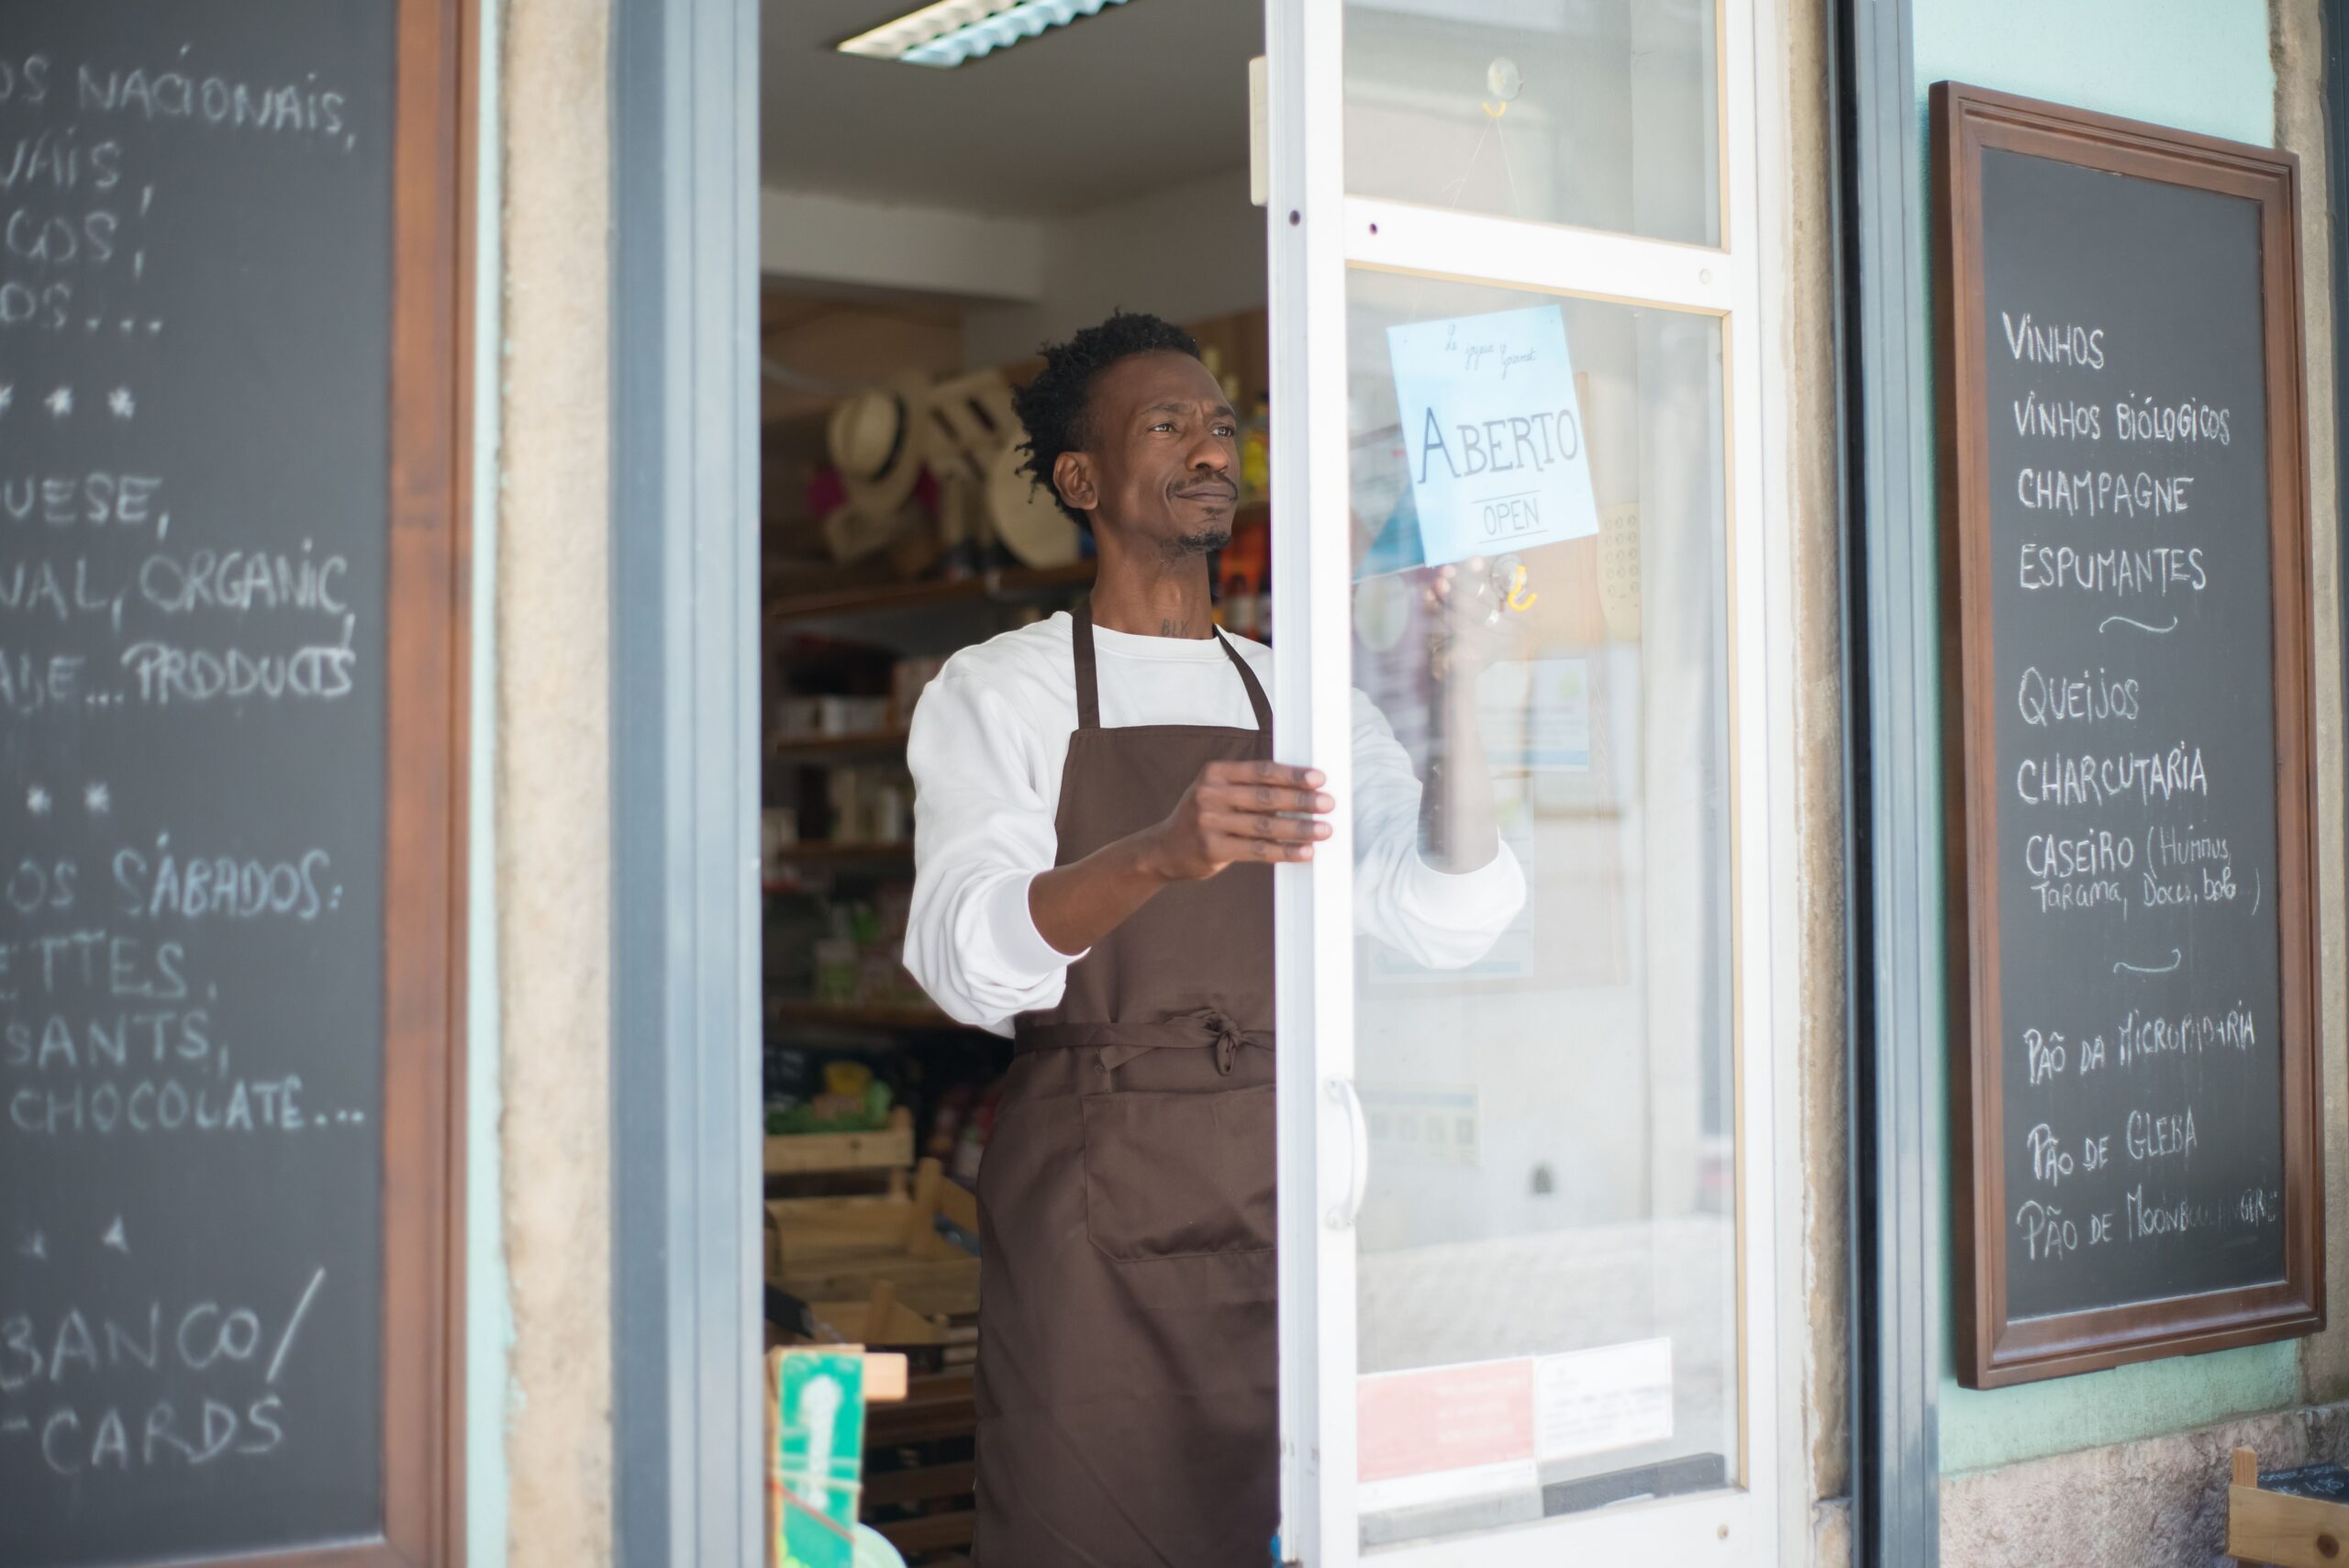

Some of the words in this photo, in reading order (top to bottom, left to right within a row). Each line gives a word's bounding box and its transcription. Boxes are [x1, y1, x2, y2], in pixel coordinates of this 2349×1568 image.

[1417, 406, 1578, 484] ABERTO
[1483, 497, 1541, 536] OPEN
[2018, 468, 2194, 517] CHAMPAGNE
[2020, 543, 2206, 597] ESPUMANTES
[120, 640, 356, 705] PRODUCTS
[2080, 1034, 2106, 1075] DA
[2083, 1135, 2110, 1172] DE
[2127, 1105, 2198, 1161] GLEBA
[2017, 1199, 2078, 1261] PÃO
[2089, 1212, 2113, 1245] DE
